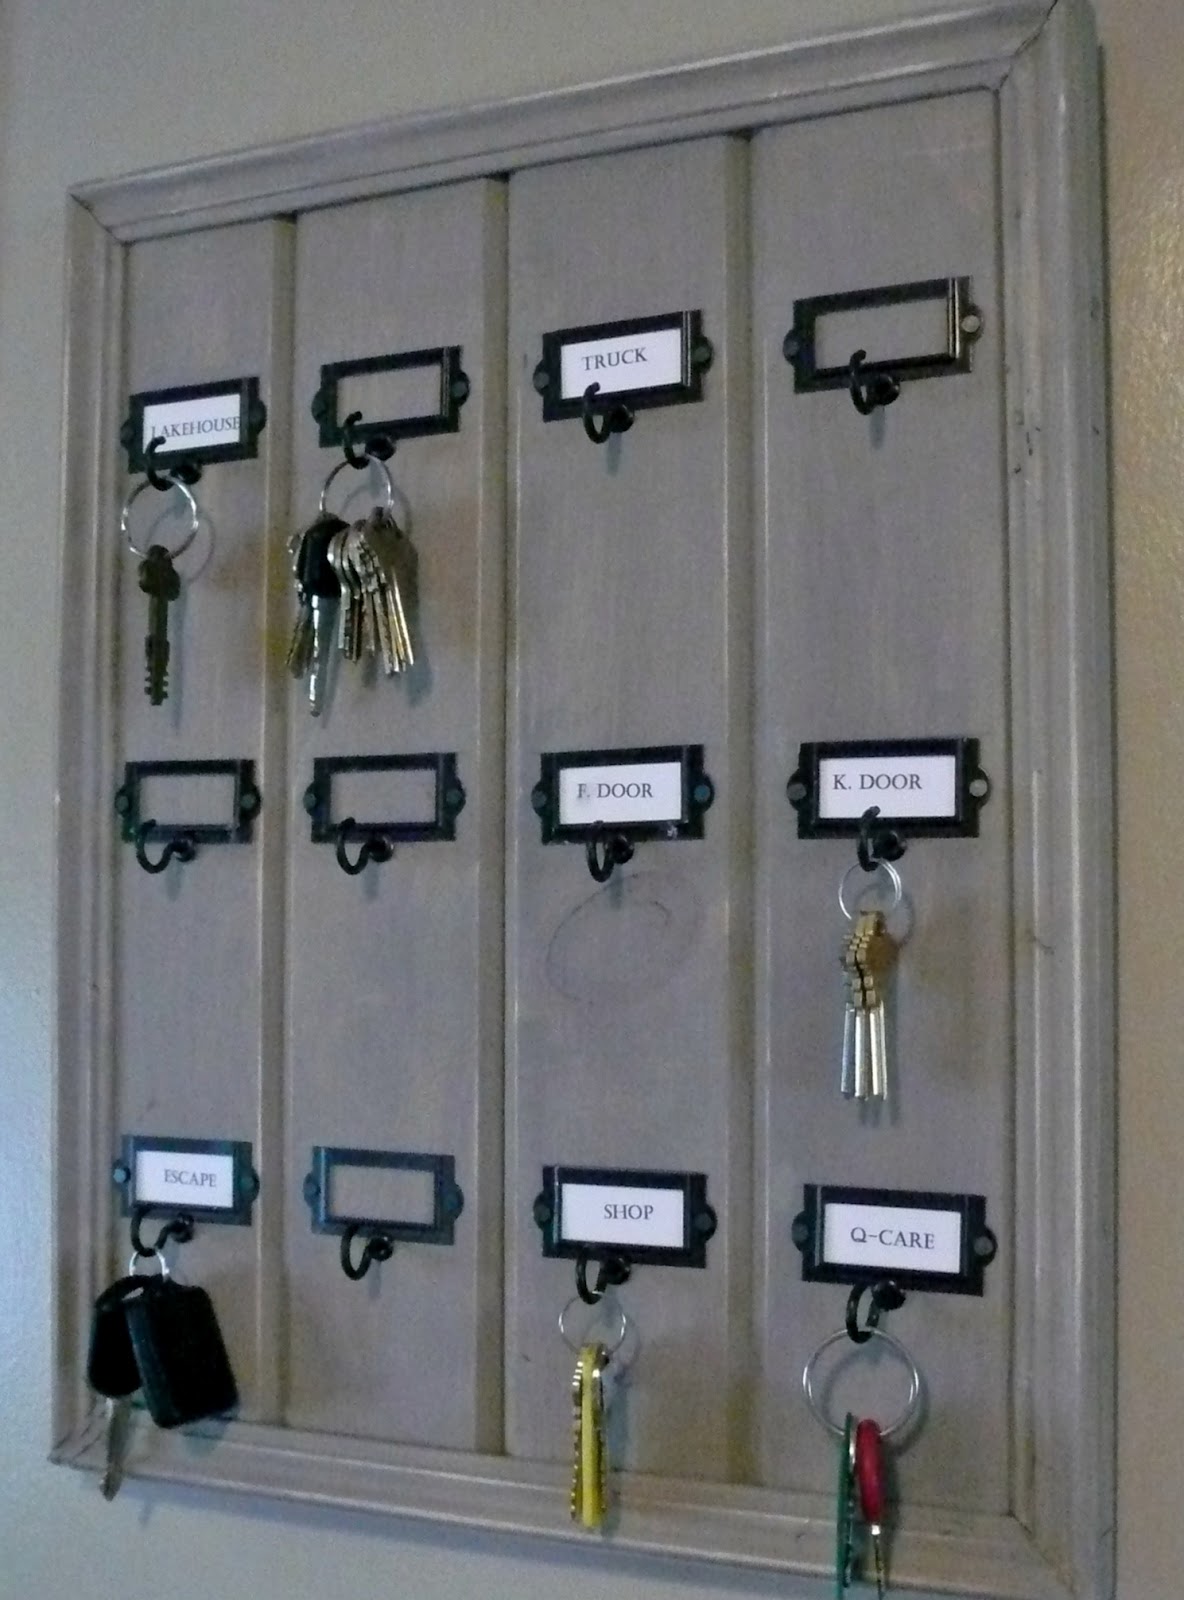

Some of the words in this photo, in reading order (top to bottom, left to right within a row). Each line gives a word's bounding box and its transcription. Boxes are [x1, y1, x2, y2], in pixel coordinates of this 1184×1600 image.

[582, 348, 647, 371] TRUCK
[833, 774, 851, 790] K.
[859, 774, 922, 790] DOOR
[597, 783, 653, 799] DOOR
[164, 1169, 216, 1188] ESCAPE
[604, 1204, 654, 1220] SHOP
[850, 1227, 935, 1250] Q-CARE
